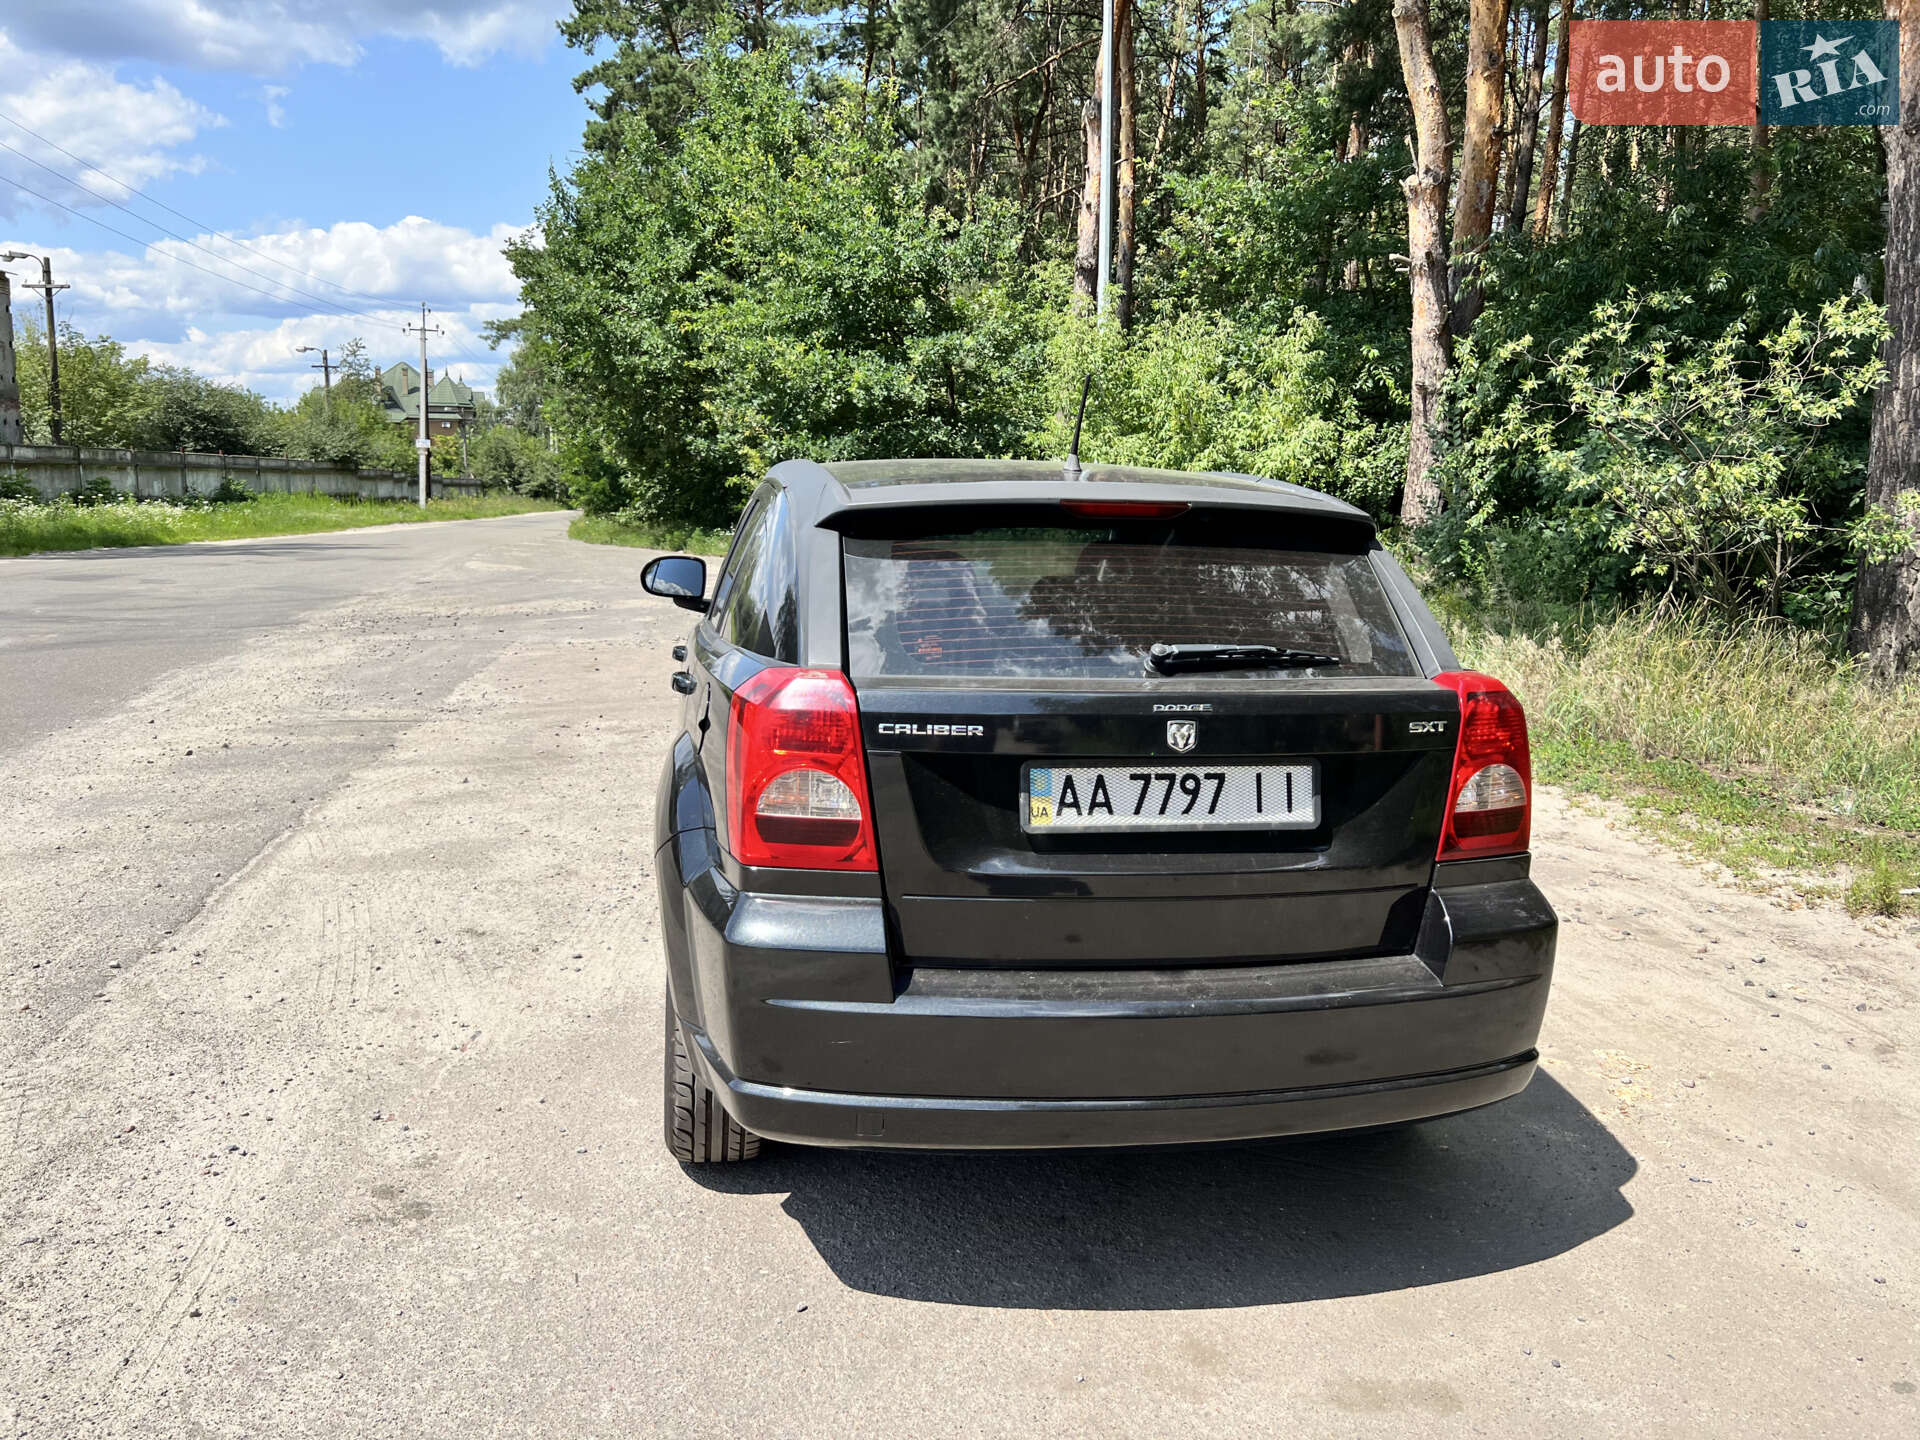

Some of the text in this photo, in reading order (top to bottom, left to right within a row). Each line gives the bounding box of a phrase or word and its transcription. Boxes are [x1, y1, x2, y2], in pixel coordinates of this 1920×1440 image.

[1152, 703, 1214, 713] DODGE
[878, 723, 984, 736] CALIBER
[1409, 720, 1448, 733] SXT
[1056, 774, 1114, 816] AA
[1129, 772, 1226, 815] 7797
[1031, 807, 1049, 818] UA
